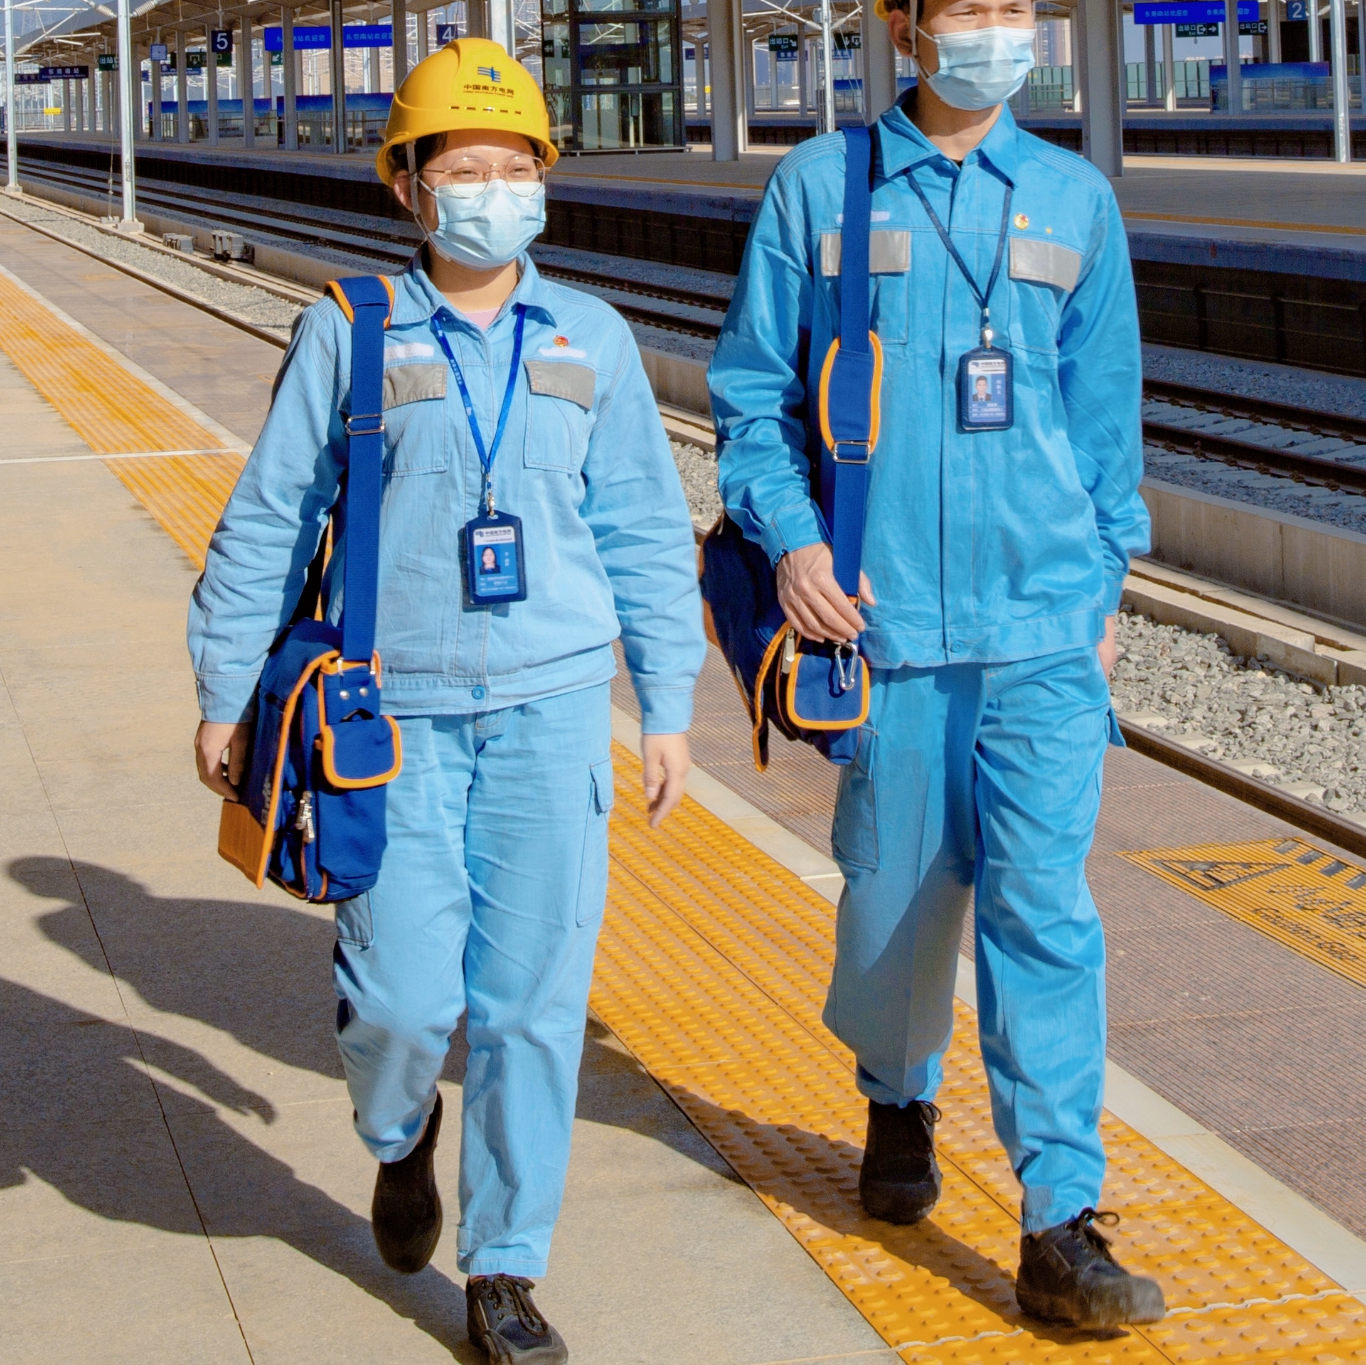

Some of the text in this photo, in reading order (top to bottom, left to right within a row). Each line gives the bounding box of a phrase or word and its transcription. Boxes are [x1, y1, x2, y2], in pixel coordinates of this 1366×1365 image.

[1292, 2, 1303, 19] 2
[216, 33, 228, 50] 5
[442, 26, 453, 42] 4
[463, 84, 515, 96] 中国南方电网
[1250, 905, 1366, 964] Caution Gap
